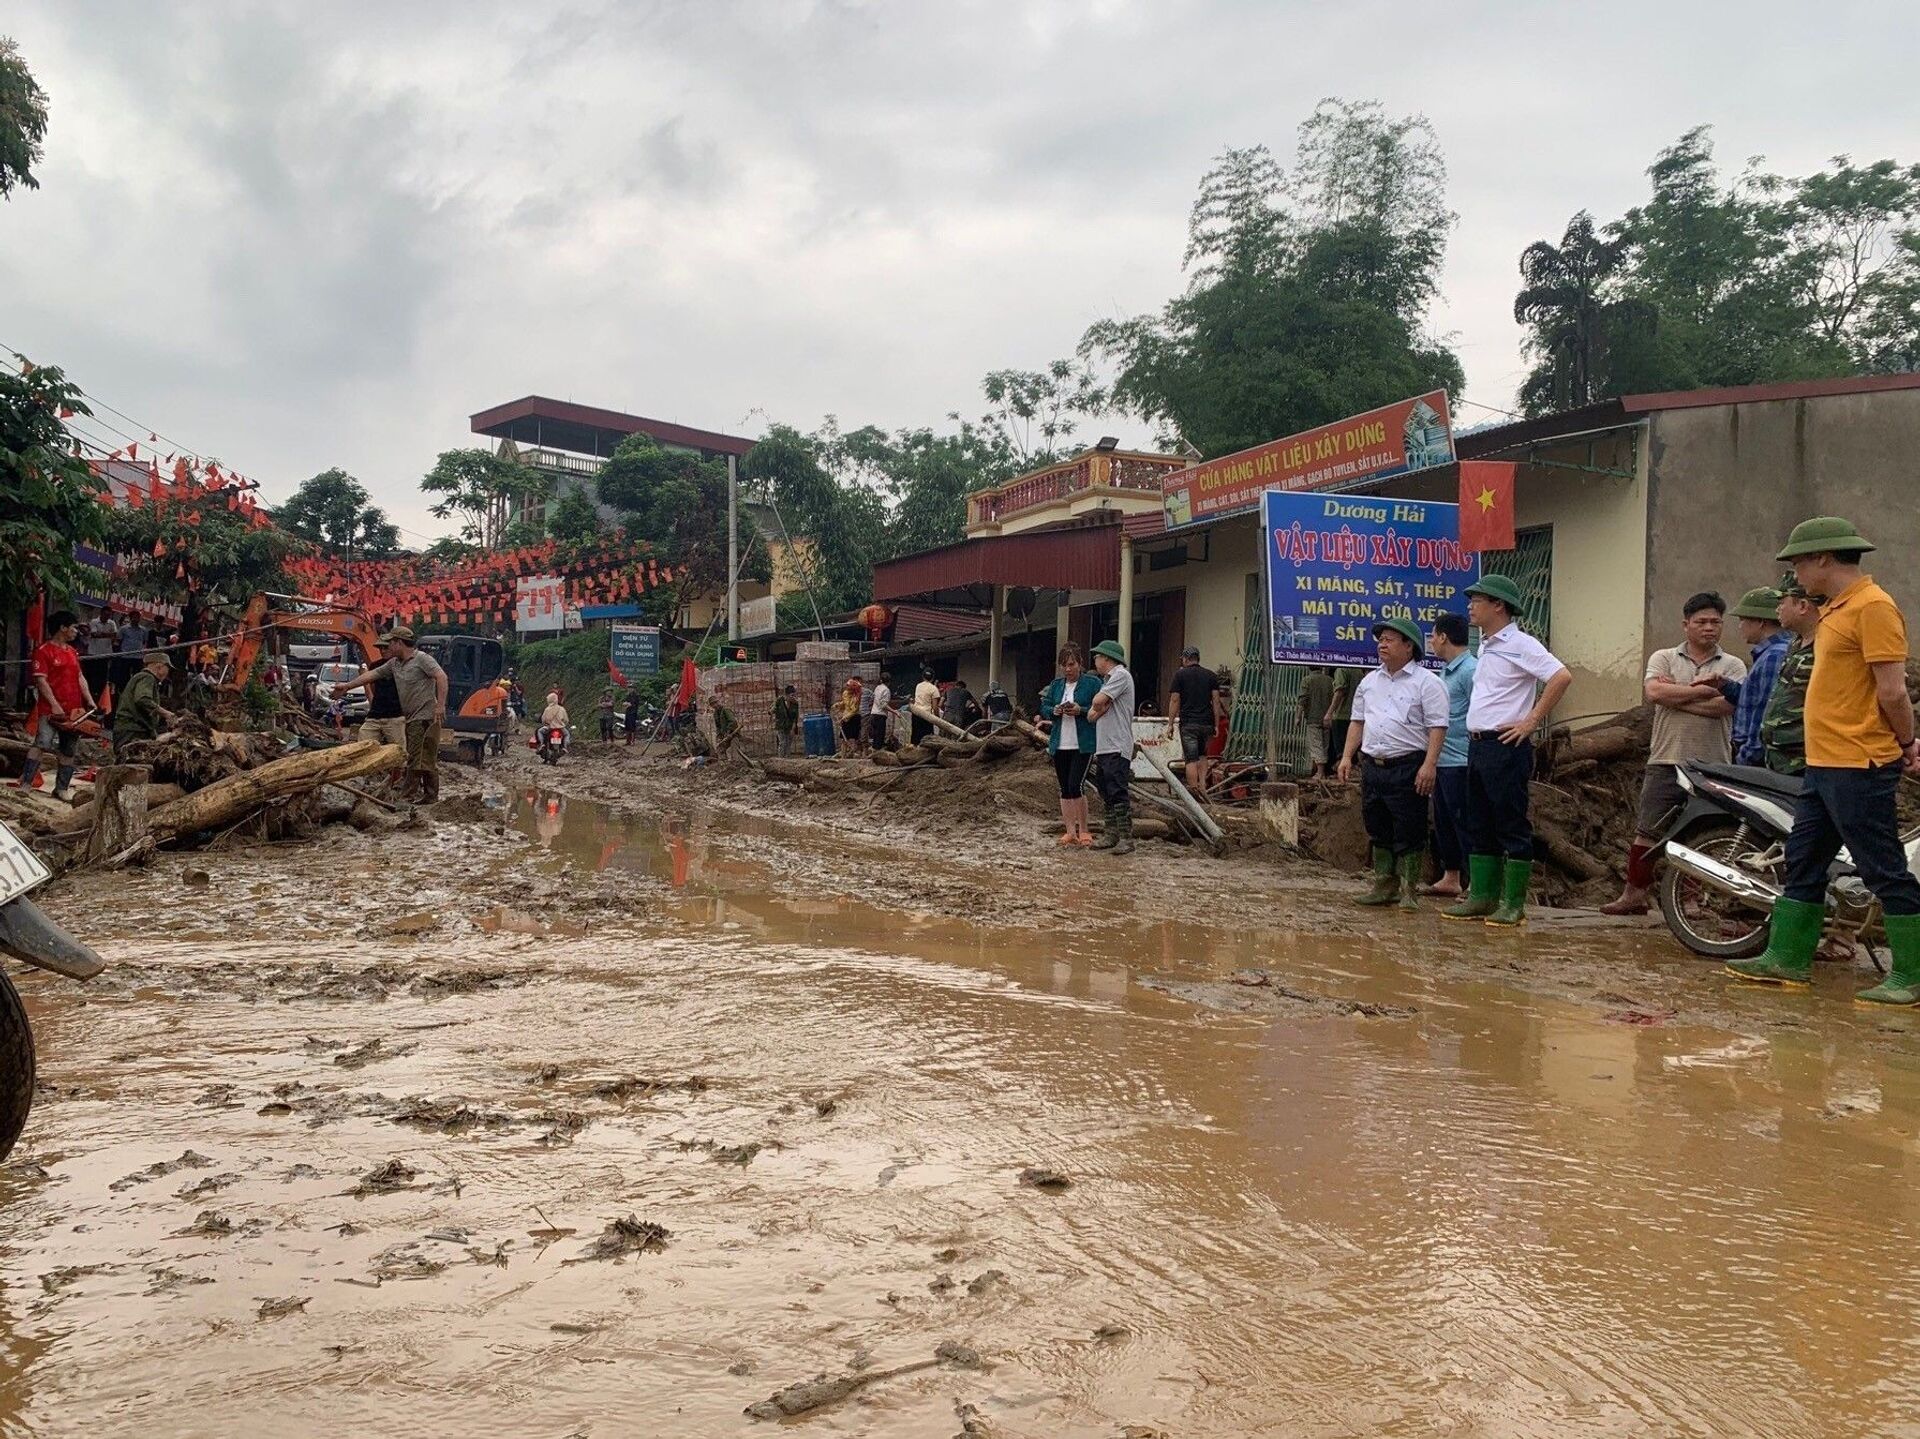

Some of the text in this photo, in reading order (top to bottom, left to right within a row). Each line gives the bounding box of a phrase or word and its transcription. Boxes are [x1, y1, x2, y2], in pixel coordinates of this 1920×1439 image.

[1200, 422, 1386, 492] CỬA HÀNG VẬT LIỆU XÂY DỰNG
[1323, 499, 1425, 523] Dương Hải
[1274, 520, 1474, 577] VẬT LIỆU XÂY DỰNG
[1296, 574, 1456, 600] XI MĂNG, SẮT, THÉP
[1302, 597, 1333, 616] MÁI
[1338, 600, 1377, 620] TÔN,
[1381, 600, 1412, 621] CỬA
[1335, 620, 1367, 641] SẮT
